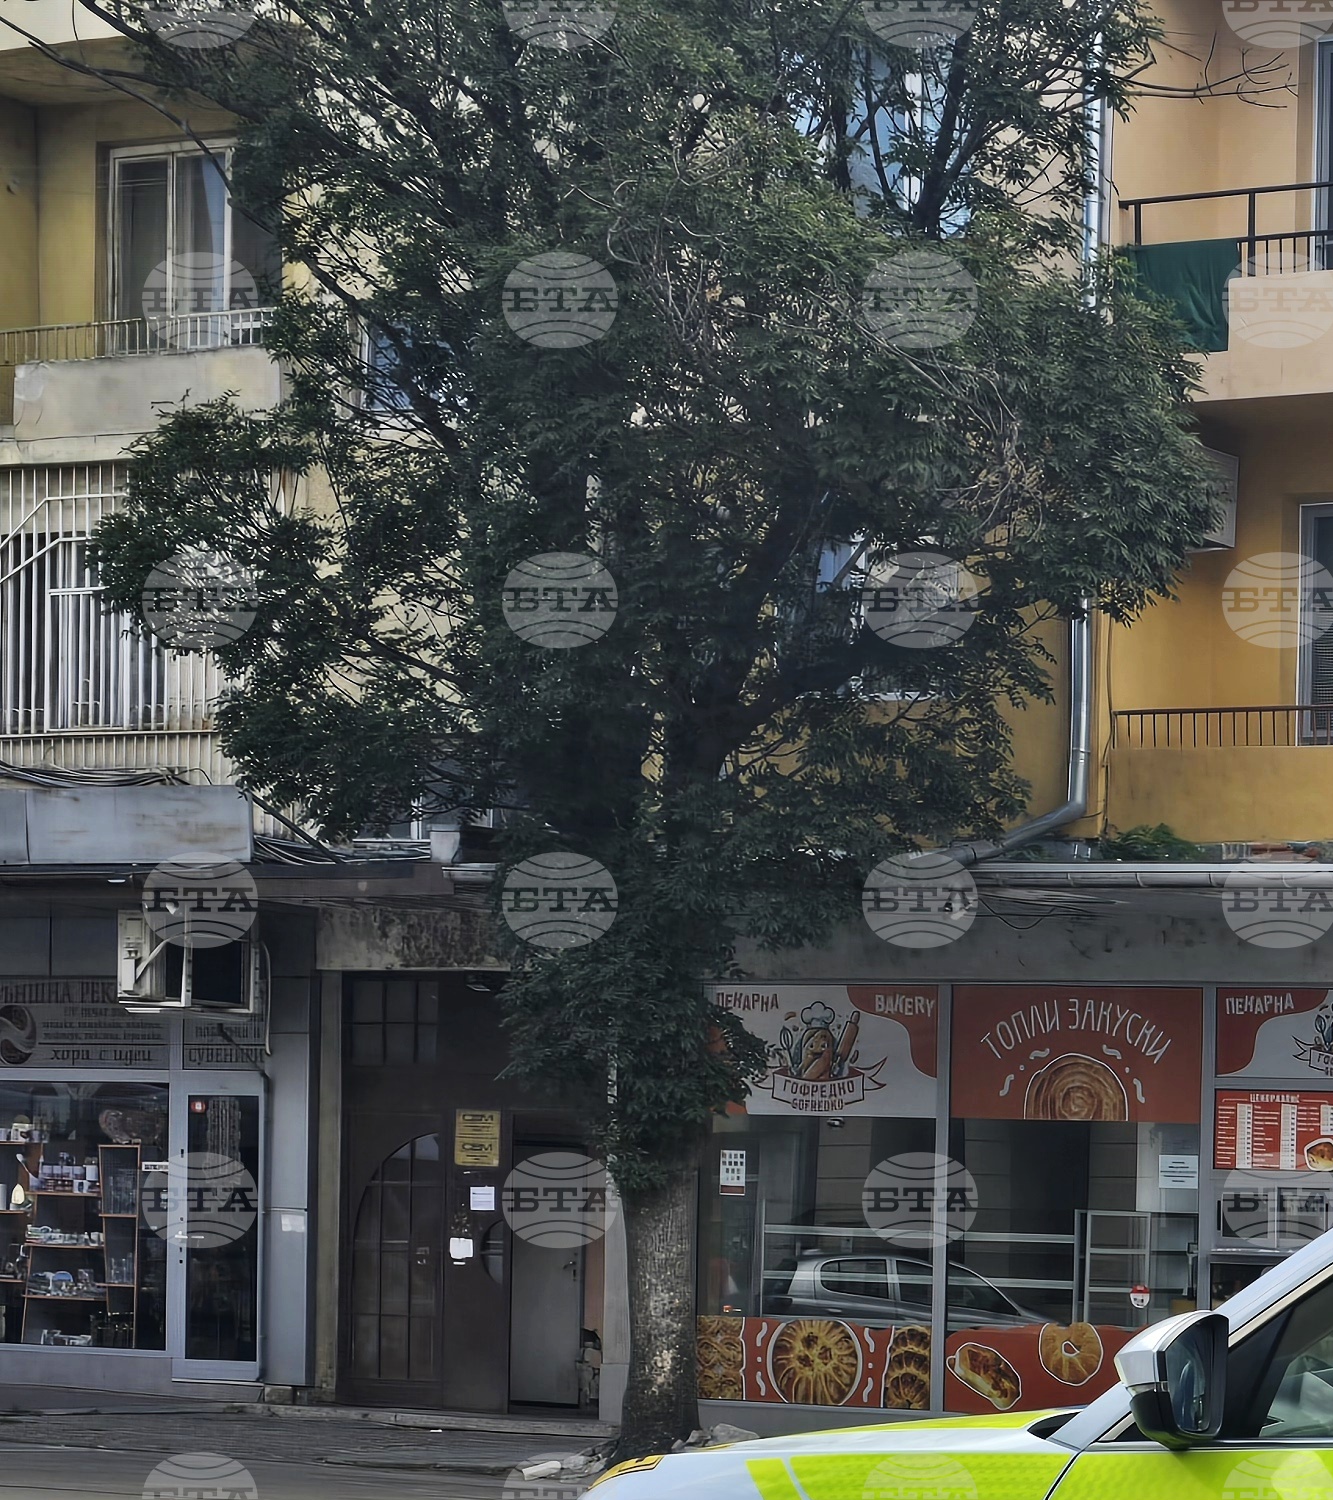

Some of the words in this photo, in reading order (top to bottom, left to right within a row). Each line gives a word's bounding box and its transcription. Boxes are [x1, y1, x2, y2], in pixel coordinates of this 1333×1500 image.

[874, 994, 936, 1018] BAKERY
[1225, 991, 1295, 1016] ПЕКАРНА
[980, 999, 1060, 1060] ТОПЛИ
[1068, 998, 1172, 1064] ЗАКУСКИ
